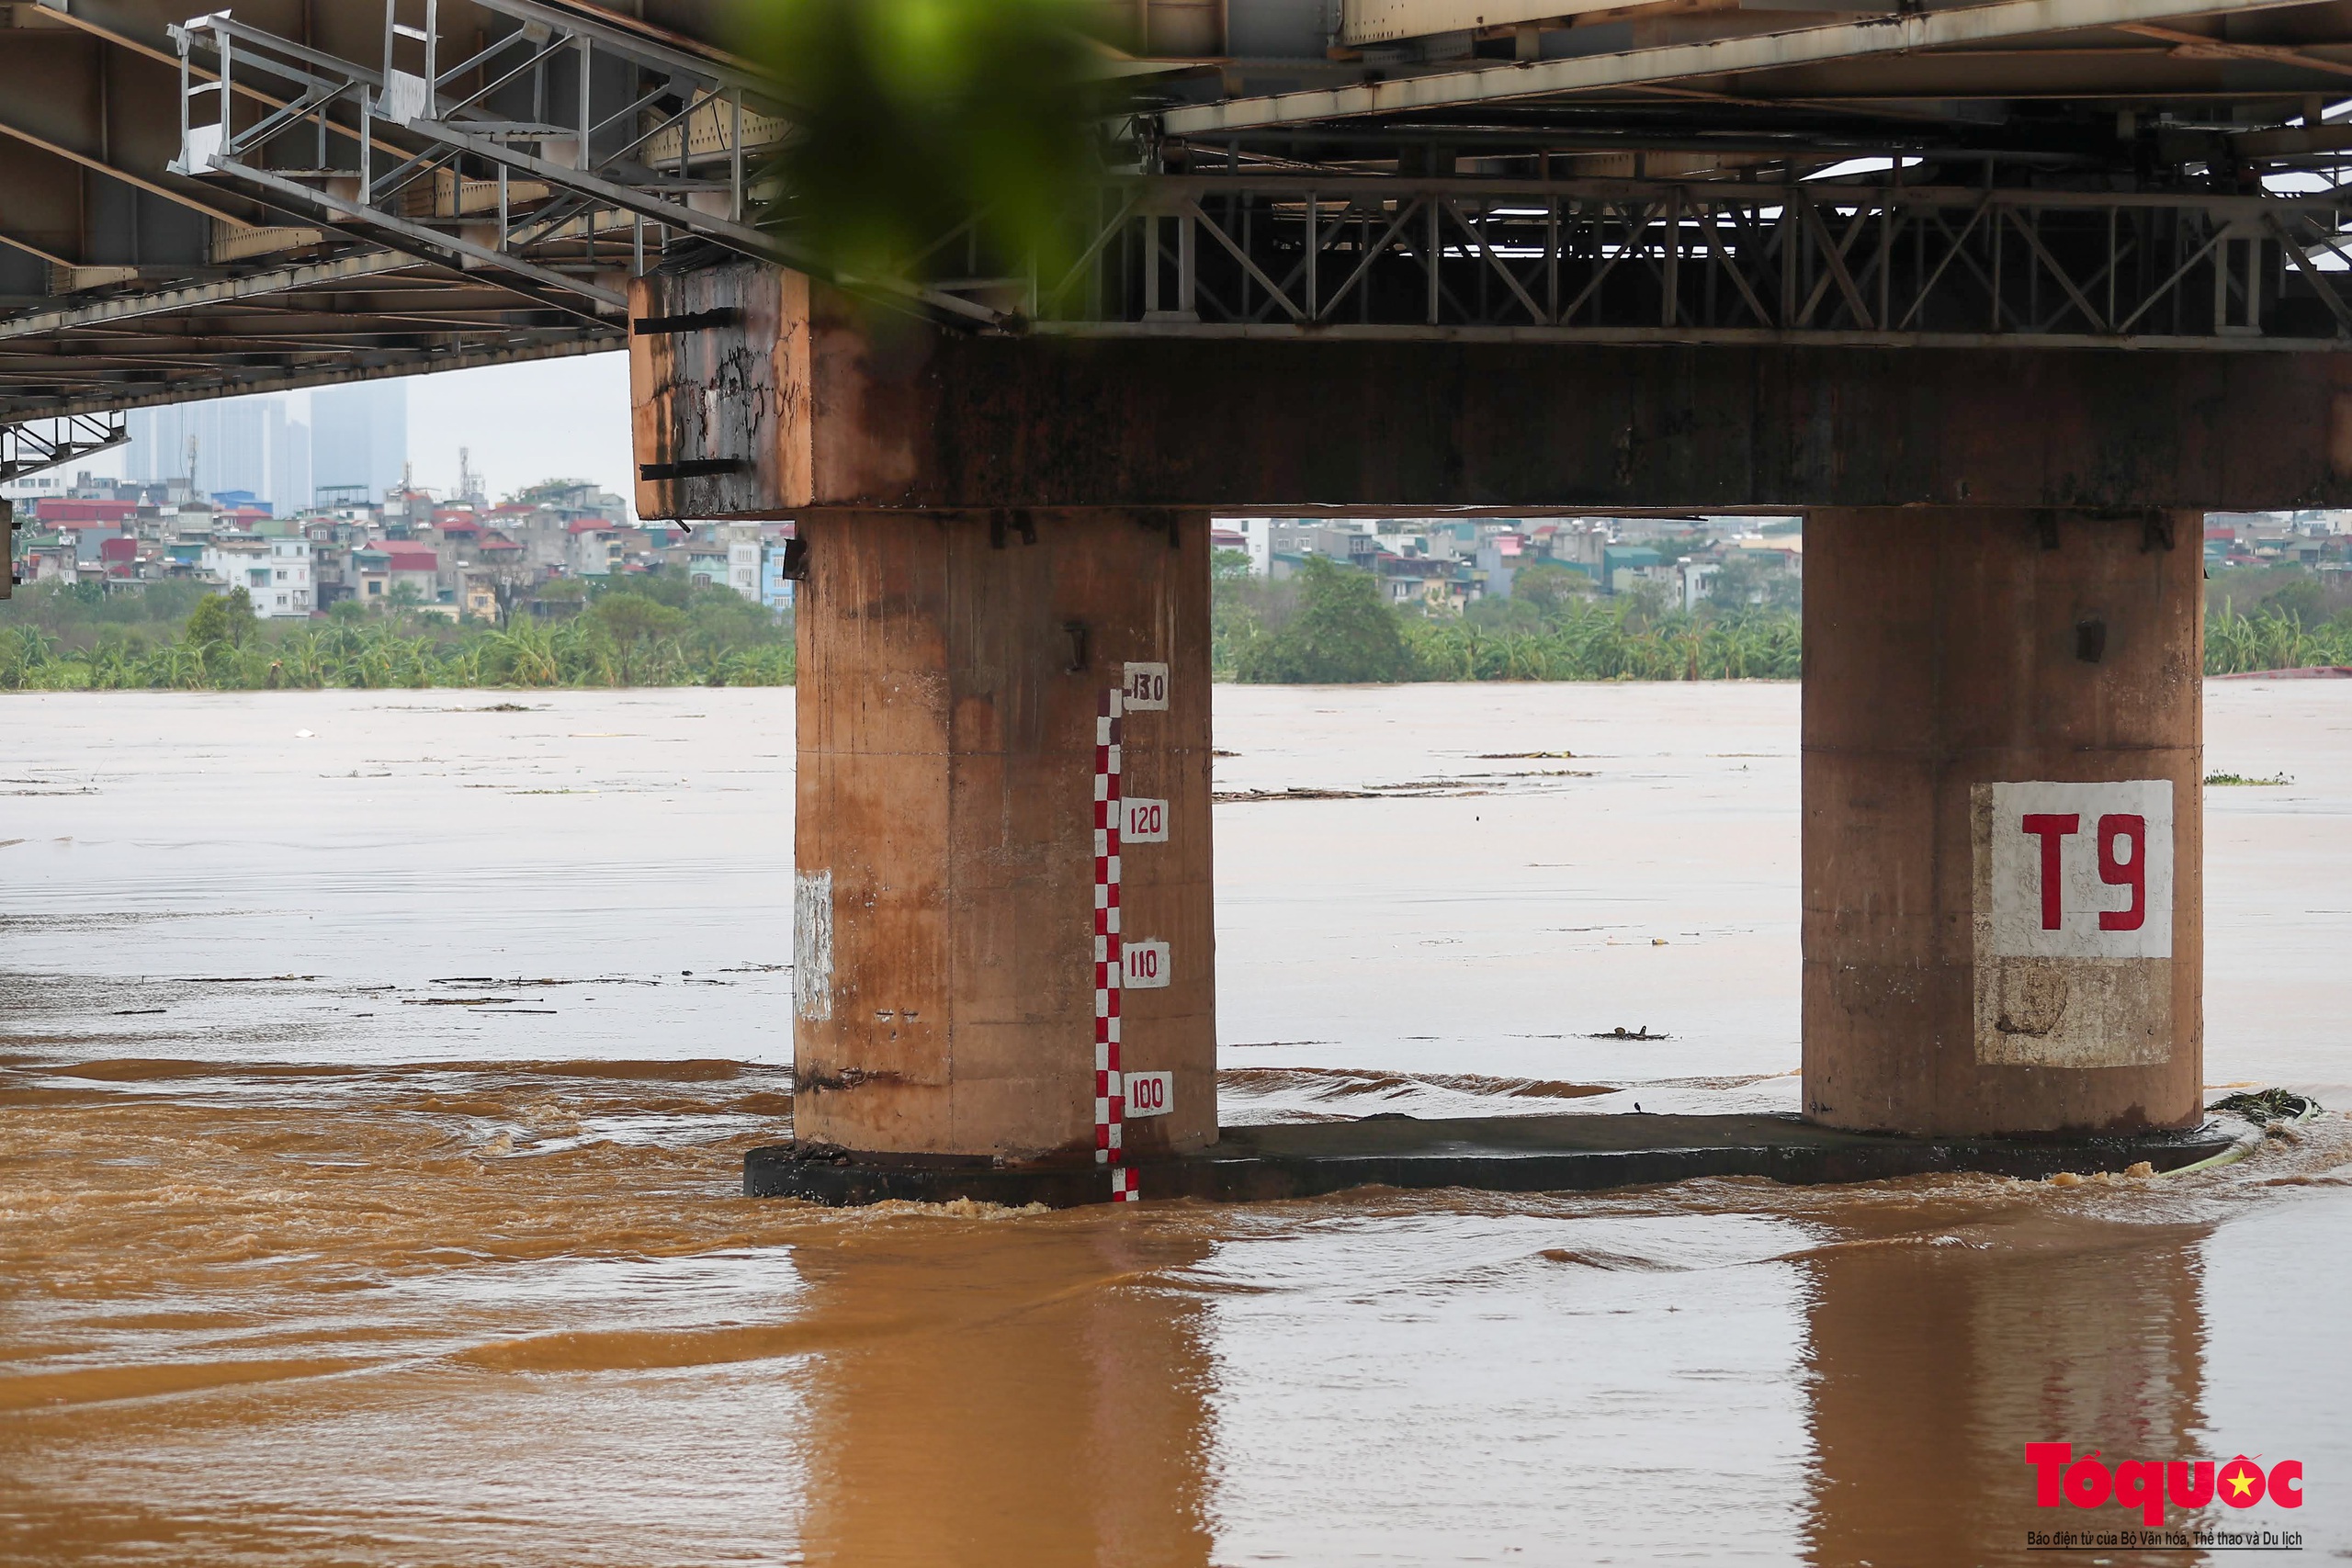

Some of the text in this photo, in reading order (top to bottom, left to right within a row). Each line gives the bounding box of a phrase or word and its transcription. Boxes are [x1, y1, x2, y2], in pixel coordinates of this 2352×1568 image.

[1133, 673, 1164, 702] 130
[1130, 805, 1161, 835] 120
[2022, 813, 2145, 931] T9
[1130, 949, 1158, 978] 110
[1133, 1077, 1164, 1109] 100
